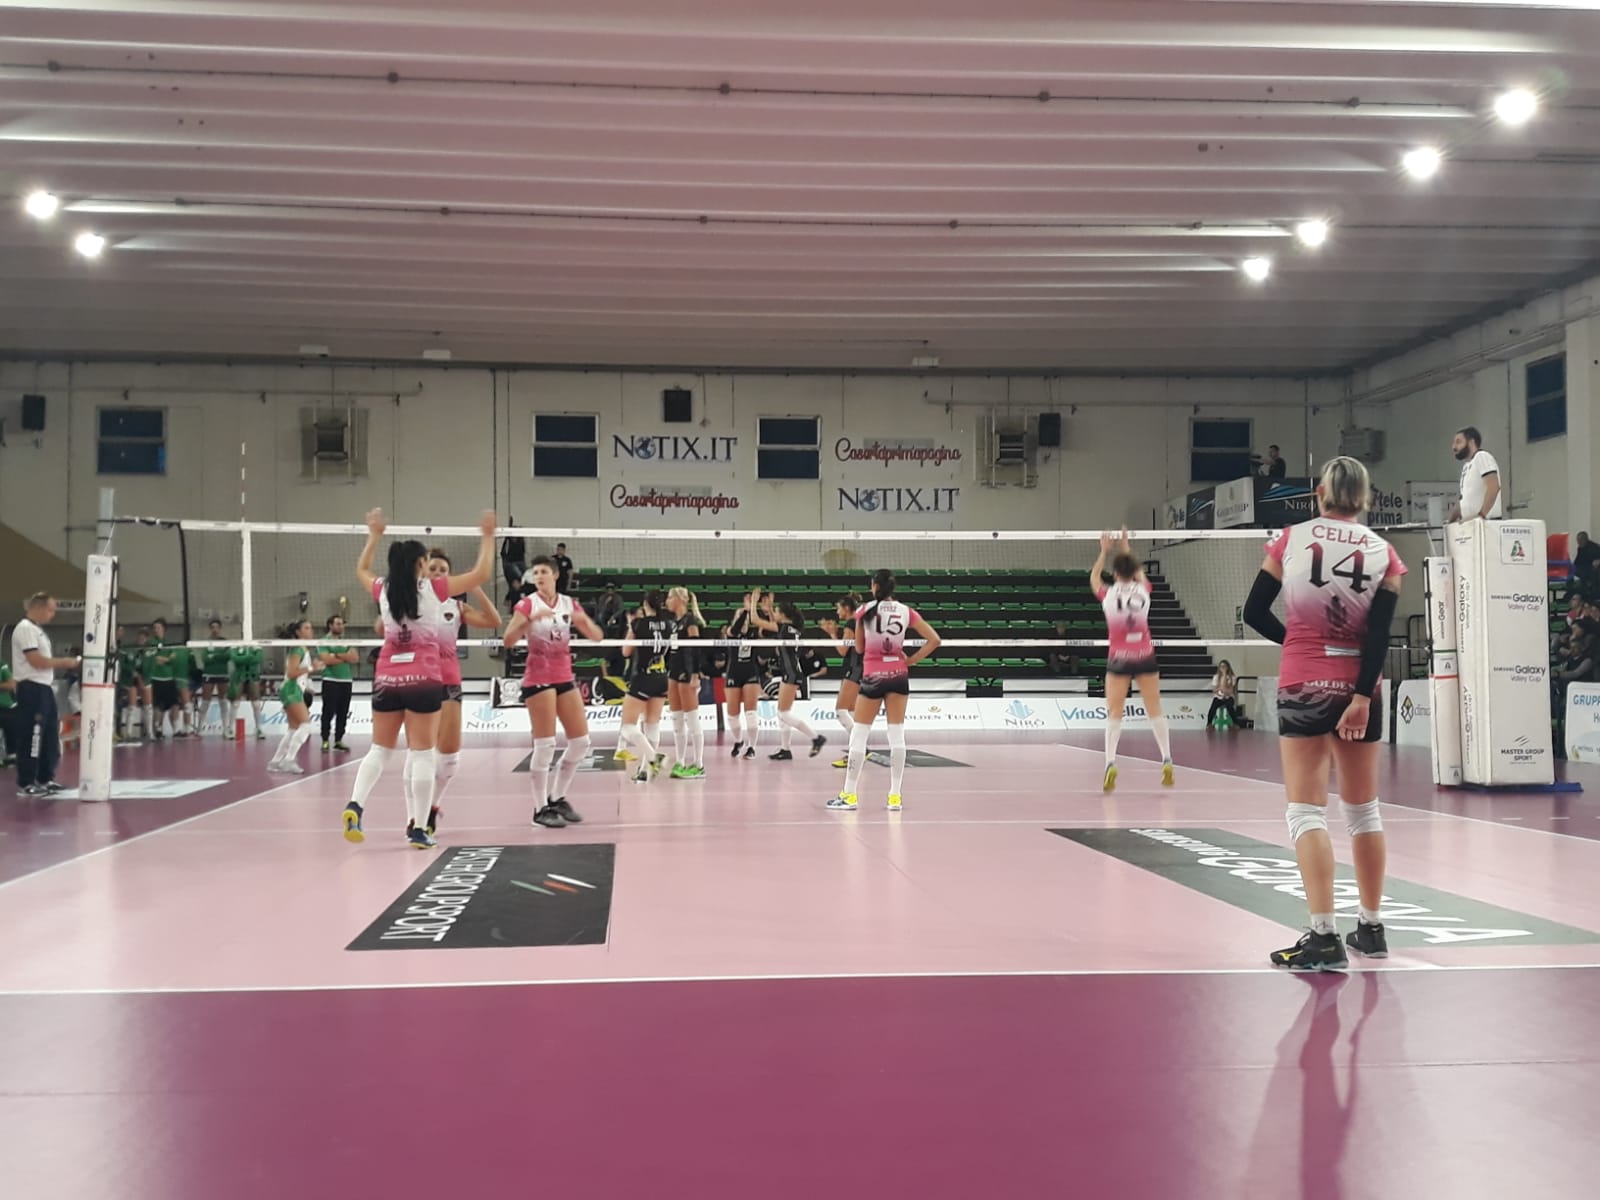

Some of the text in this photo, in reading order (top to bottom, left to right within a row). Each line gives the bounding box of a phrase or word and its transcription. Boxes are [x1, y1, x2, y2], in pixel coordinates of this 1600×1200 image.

[612, 434, 738, 461] NOTIX.IT
[837, 487, 960, 512] NOTIX.IT
[1312, 524, 1370, 548] CELLA
[1304, 541, 1373, 595] 14
[1458, 575, 1467, 622] Galaxy
[1512, 593, 1545, 605] Galaxy
[874, 614, 903, 635] 15
[1514, 664, 1546, 676] Galaxy
[414, 873, 488, 905] GROUP
[379, 904, 467, 942] SPORT
